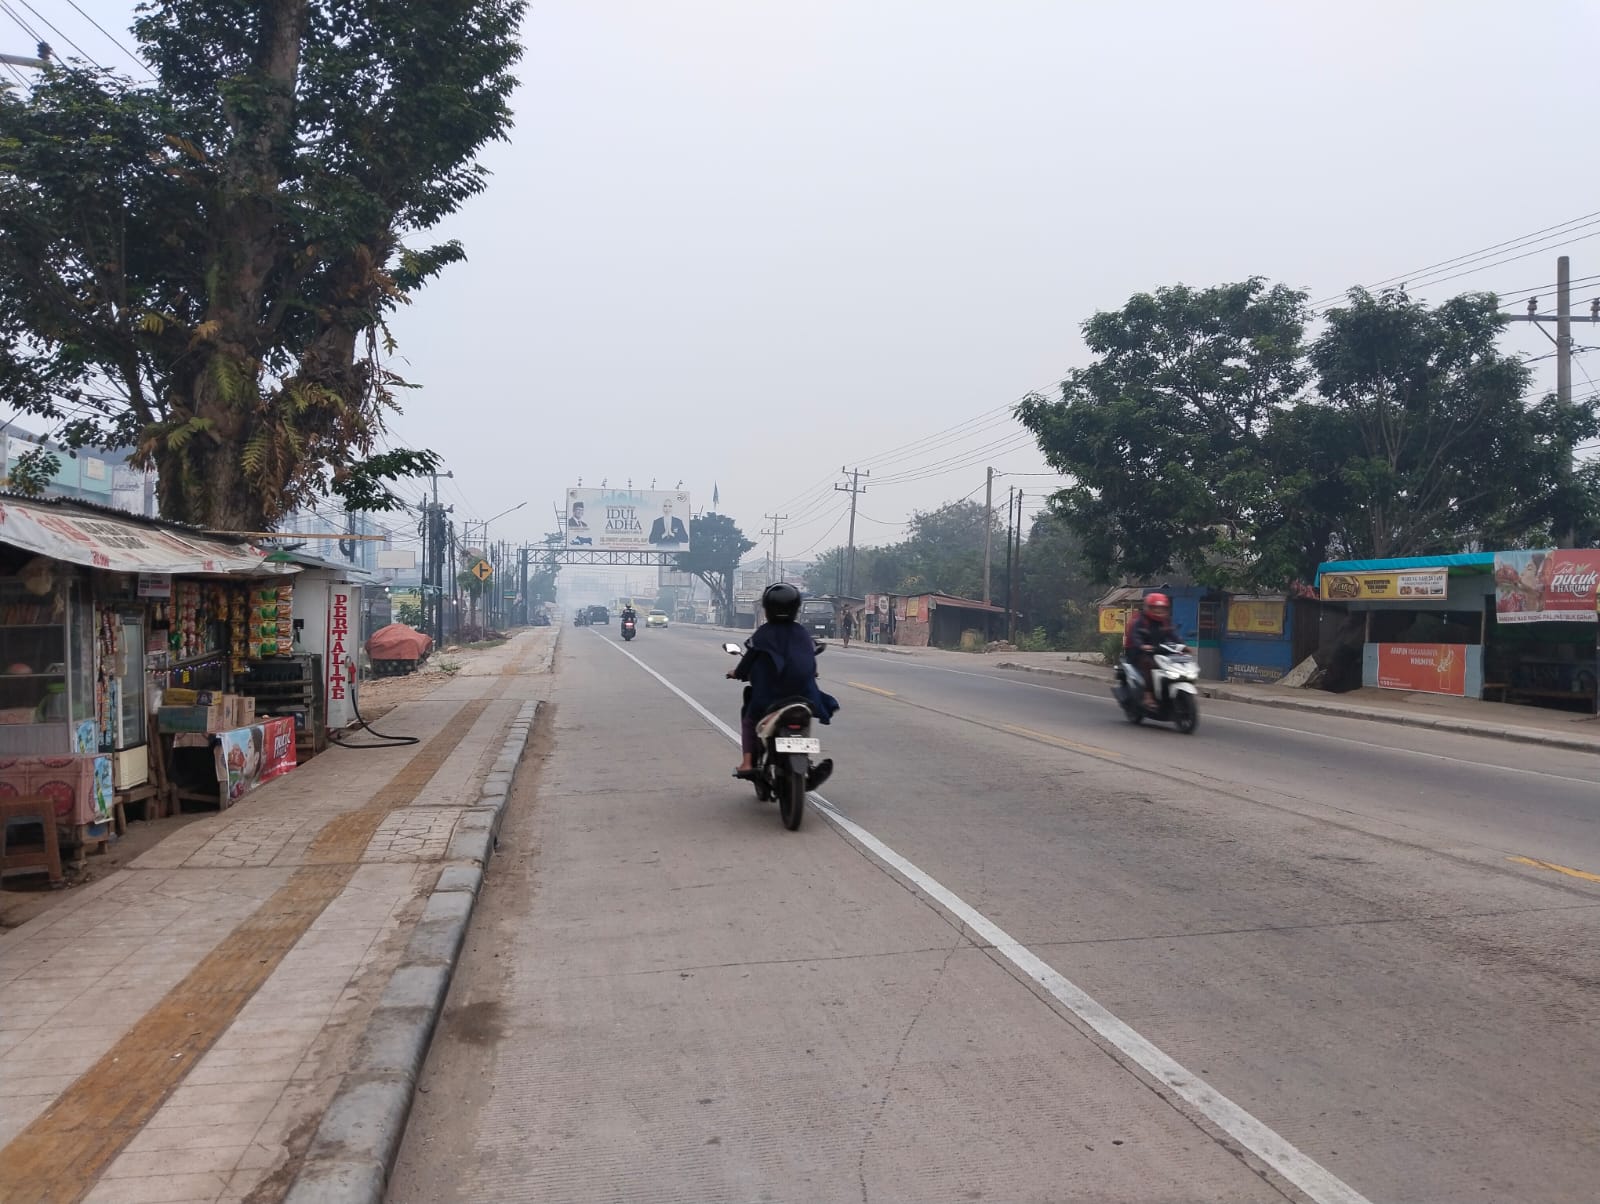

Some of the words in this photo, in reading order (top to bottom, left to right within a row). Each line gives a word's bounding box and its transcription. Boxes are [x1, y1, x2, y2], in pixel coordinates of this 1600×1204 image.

[606, 509, 637, 520] IDUL
[605, 519, 642, 530] ADHA
[330, 594, 348, 700] PERTALITE
